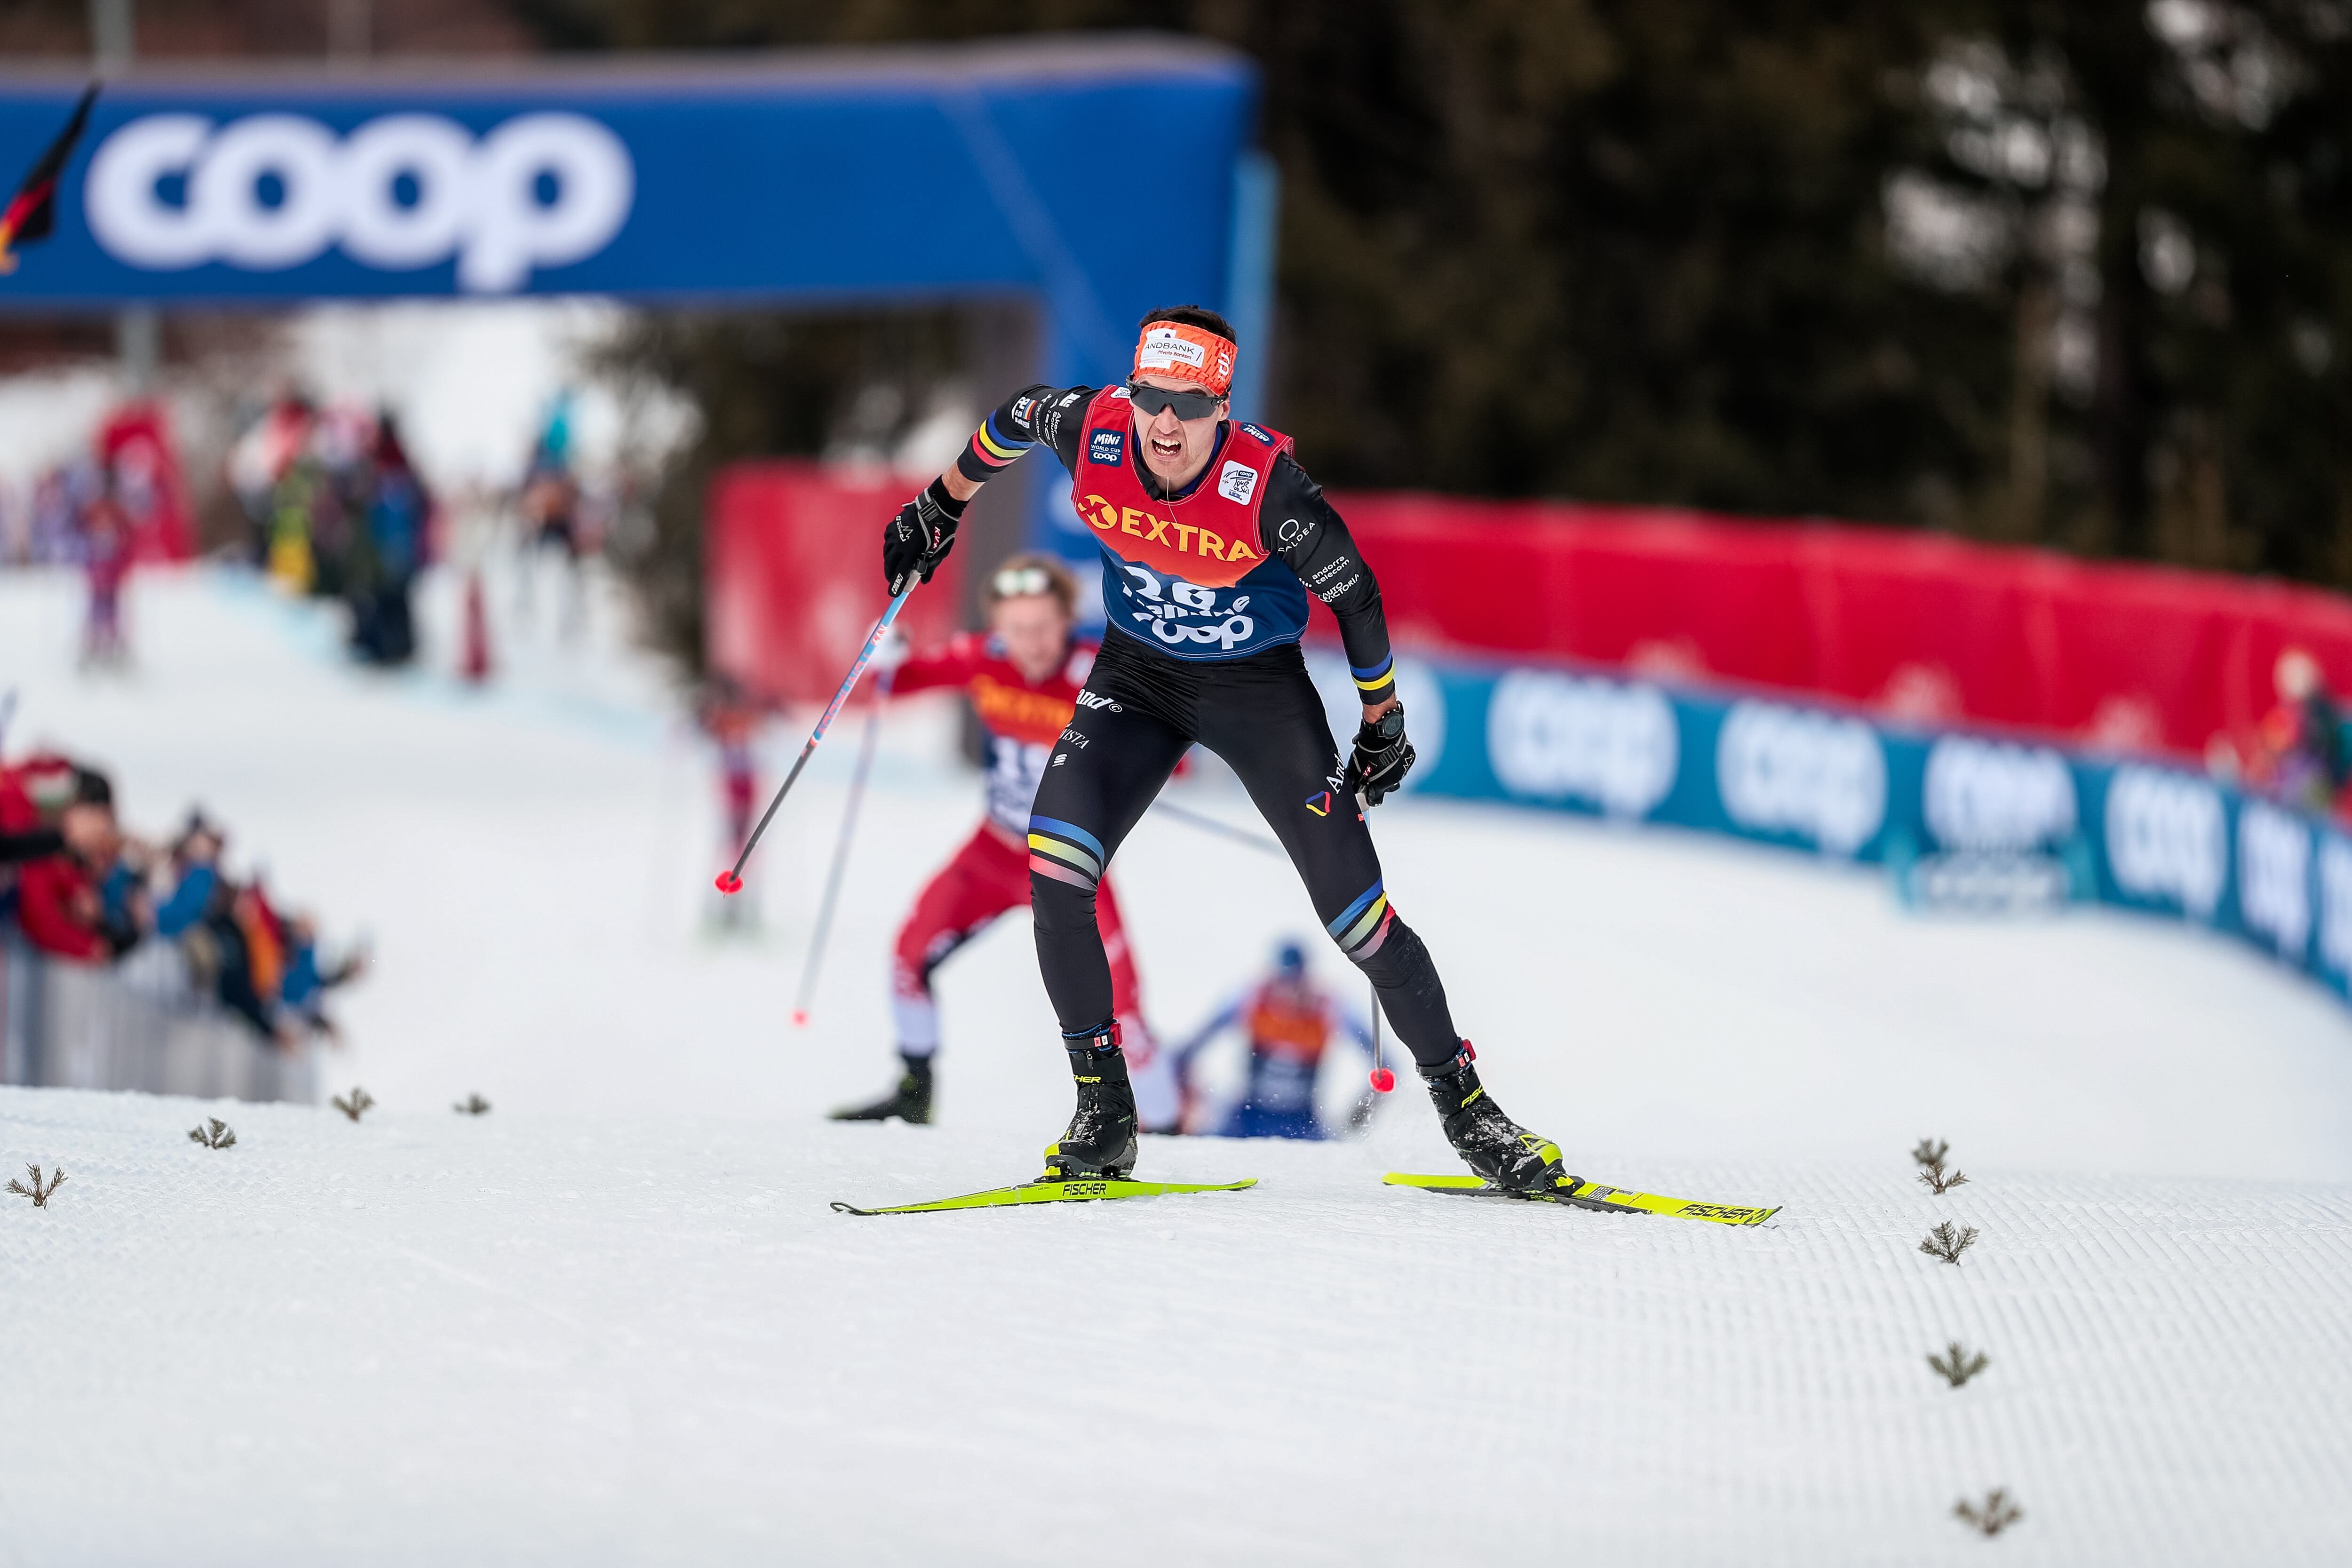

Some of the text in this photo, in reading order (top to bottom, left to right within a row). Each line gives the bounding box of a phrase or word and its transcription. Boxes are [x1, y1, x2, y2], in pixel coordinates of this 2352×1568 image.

[85, 113, 635, 293] coop
[1144, 342, 1195, 355] ANDBANK
[1173, 351, 1192, 360] Bankers
[1093, 452, 1117, 462] coop
[1311, 556, 1345, 580] andorra
[1315, 559, 1350, 585] telecom
[1073, 1074, 1101, 1083] HER
[1062, 1183, 1107, 1197] FISCHER
[1530, 1194, 1557, 1203] FISCHER
[1675, 1204, 1755, 1220] FISCHER
